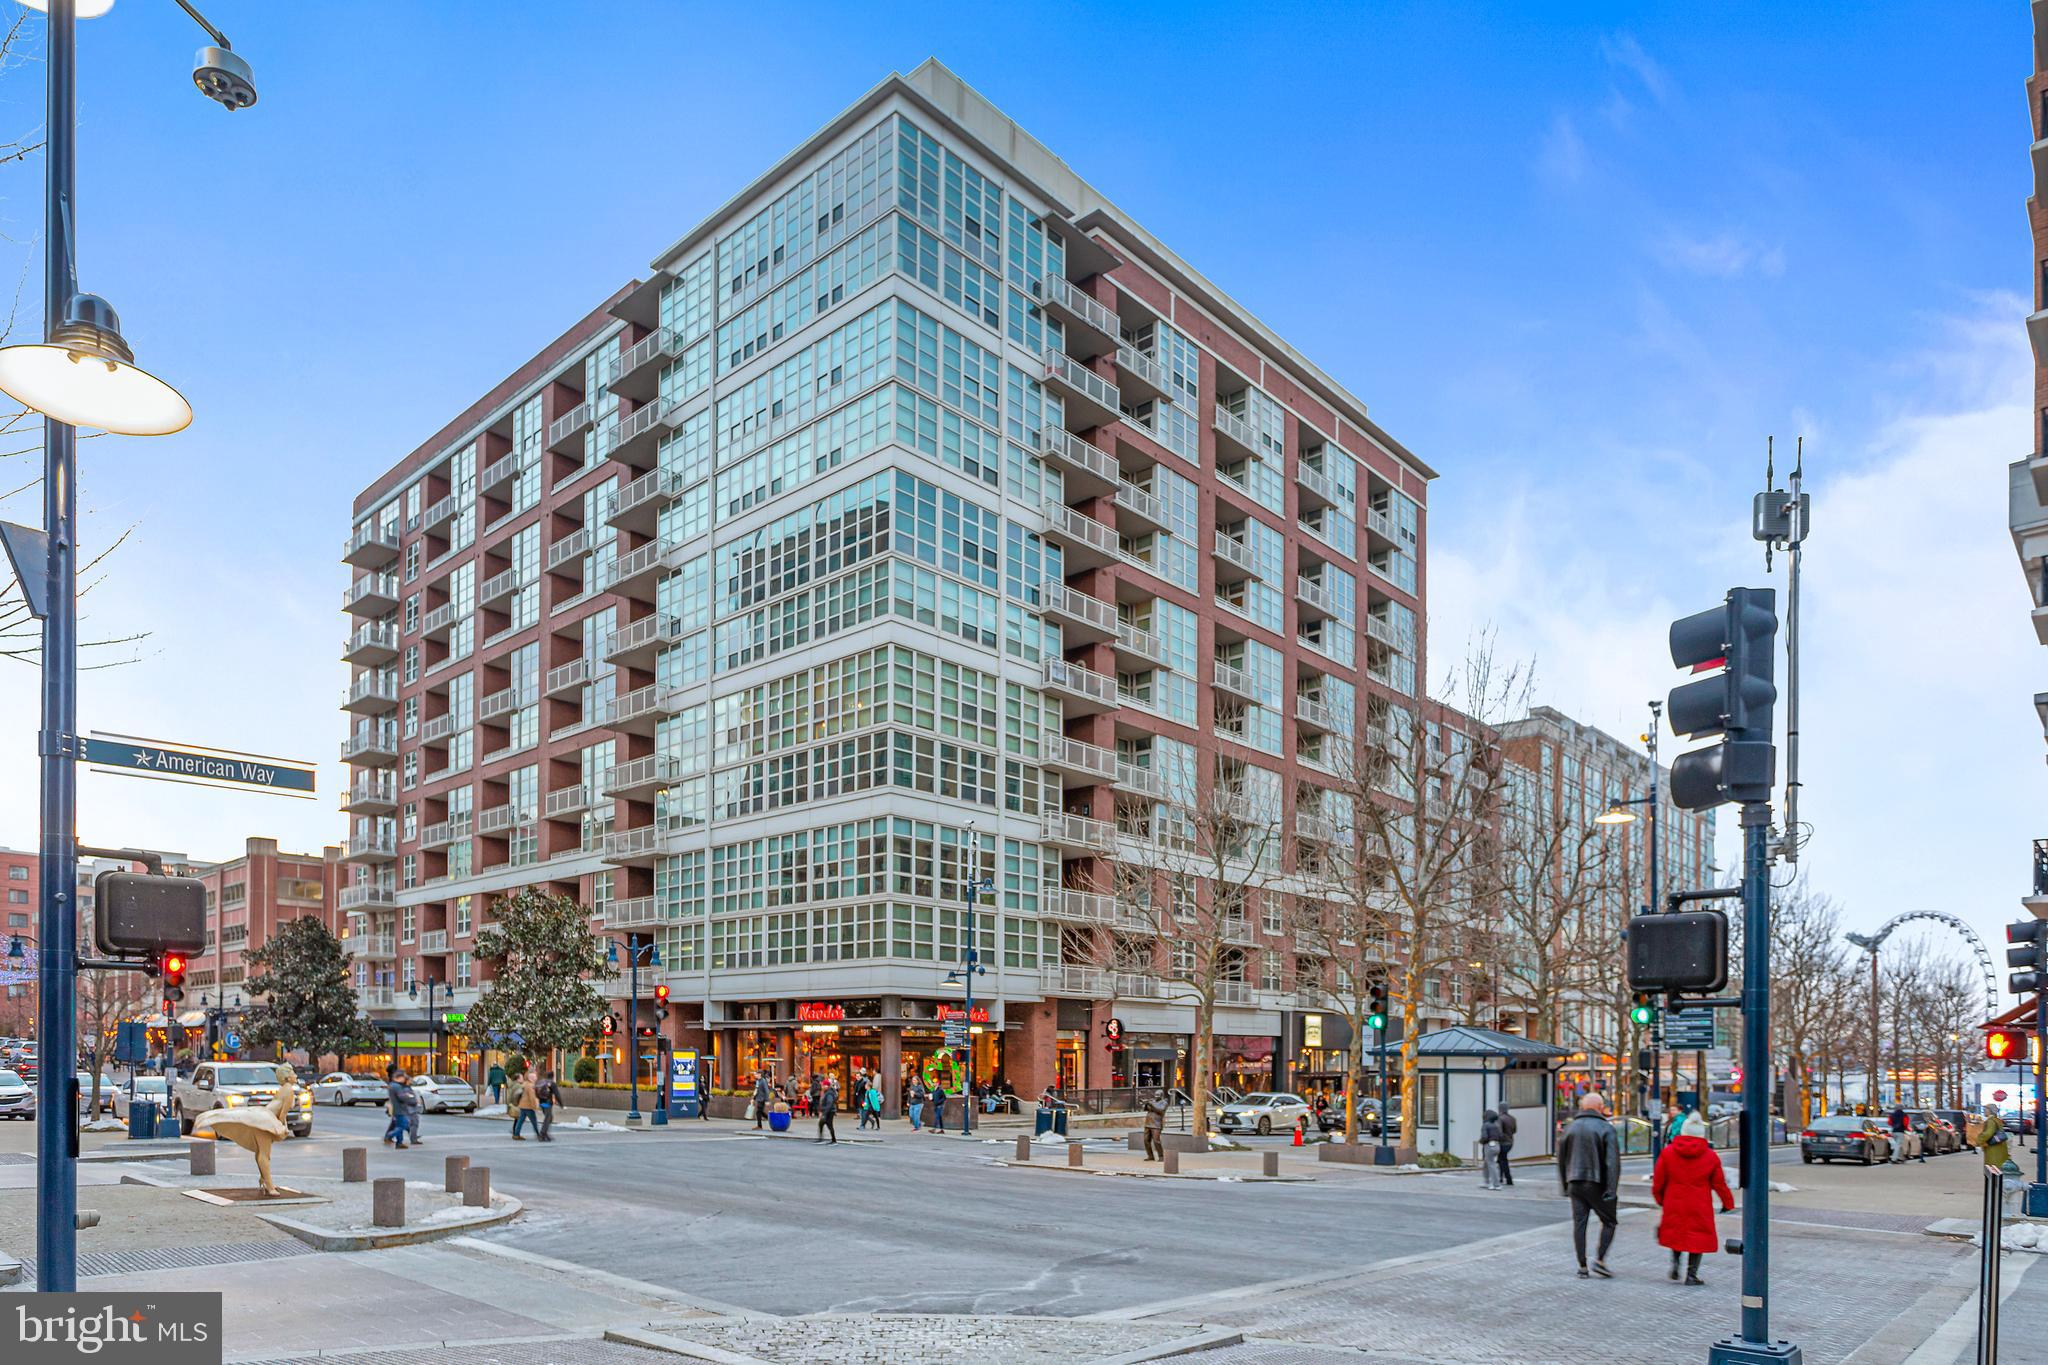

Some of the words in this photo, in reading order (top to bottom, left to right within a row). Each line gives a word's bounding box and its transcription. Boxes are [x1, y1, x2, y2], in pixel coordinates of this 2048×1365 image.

[155, 751, 234, 778] American
[240, 762, 275, 786] Way
[798, 1003, 846, 1021] Nando's
